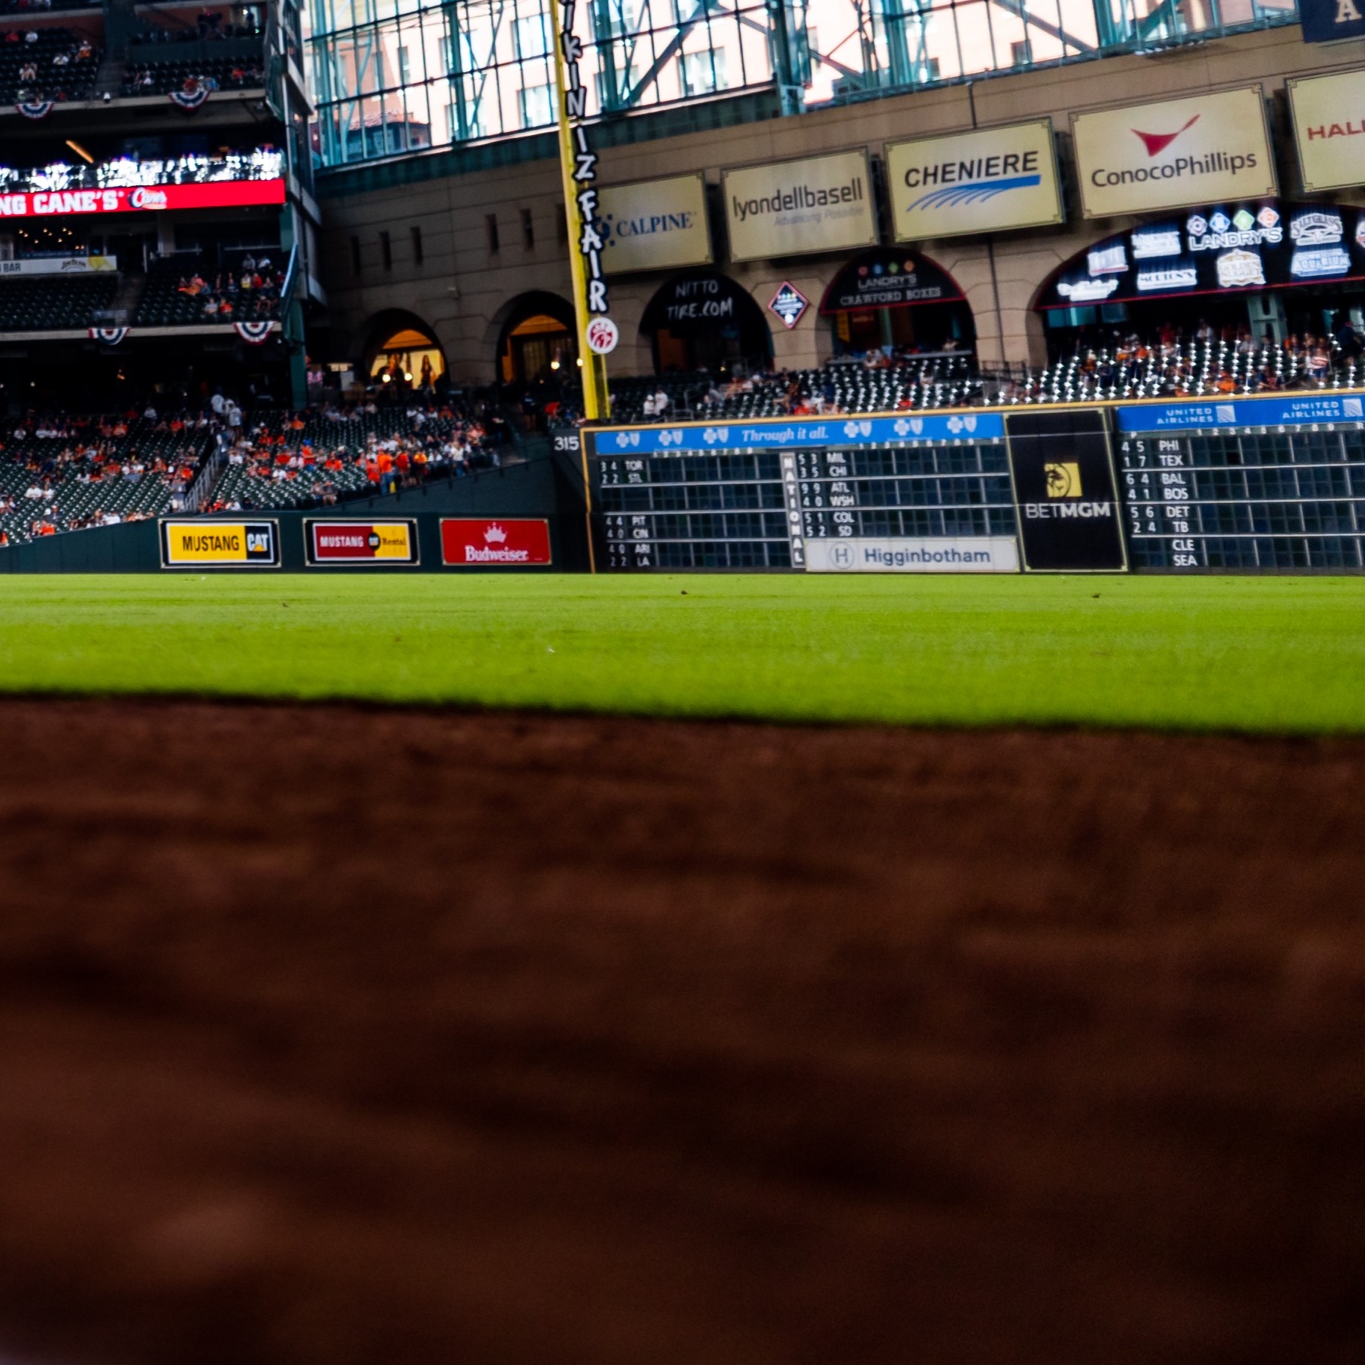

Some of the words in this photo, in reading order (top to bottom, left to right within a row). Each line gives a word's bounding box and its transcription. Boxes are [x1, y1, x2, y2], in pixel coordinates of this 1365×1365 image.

[1307, 120, 1365, 141] HAL
[575, 127, 596, 180] IZ
[904, 150, 1039, 188] CHENIERE
[1091, 152, 1257, 188] ConocoPhillips
[33, 190, 119, 216] CANE'S
[132, 187, 167, 210] Cane's
[732, 177, 864, 221] lyondellbasell
[615, 212, 692, 239] CALPINE
[1188, 227, 1283, 252] LANDRY'S
[578, 190, 607, 312] FAIR
[3, 262, 21, 273] BAR
[857, 274, 917, 290] LANDRY'S
[675, 279, 719, 298] NITTO
[840, 288, 902, 306] CRAWFORD
[906, 287, 942, 300] BOXES
[666, 298, 734, 320] TIRE.COM
[1166, 407, 1212, 417] UNITED
[1292, 401, 1339, 412] UNITED
[1157, 414, 1214, 424] AIRLINES
[1283, 408, 1341, 419] AIRLINES
[742, 427, 794, 443] Through
[797, 428, 806, 439] it
[809, 426, 829, 438] all.
[554, 436, 580, 451] 315
[1159, 440, 1179, 452] PHI
[826, 453, 846, 463] MIL
[1159, 455, 1183, 466] TEX
[625, 460, 643, 471] TOR
[829, 466, 847, 477] CHI
[628, 473, 643, 483] STL
[1161, 473, 1185, 484] BAL
[831, 482, 850, 492] ATL
[1164, 488, 1189, 500] BOS
[830, 495, 854, 506] WSH
[783, 458, 803, 563] NATIONAL
[1025, 502, 1111, 518] BETMGM
[1166, 506, 1190, 517] DET
[632, 515, 646, 525] PIT
[833, 512, 854, 523] COL
[838, 526, 852, 536] SD
[1173, 521, 1189, 533] TB
[633, 528, 649, 539] CIN
[182, 535, 239, 552] MUSTANG
[246, 533, 268, 552] CAT
[320, 535, 364, 548] MUSTANG
[1172, 539, 1194, 551] CLE
[465, 545, 529, 561] Budweiser
[635, 544, 651, 554] ARI
[637, 557, 650, 567] LA
[864, 547, 990, 566] Higginbotham
[1173, 554, 1197, 566] SEA
